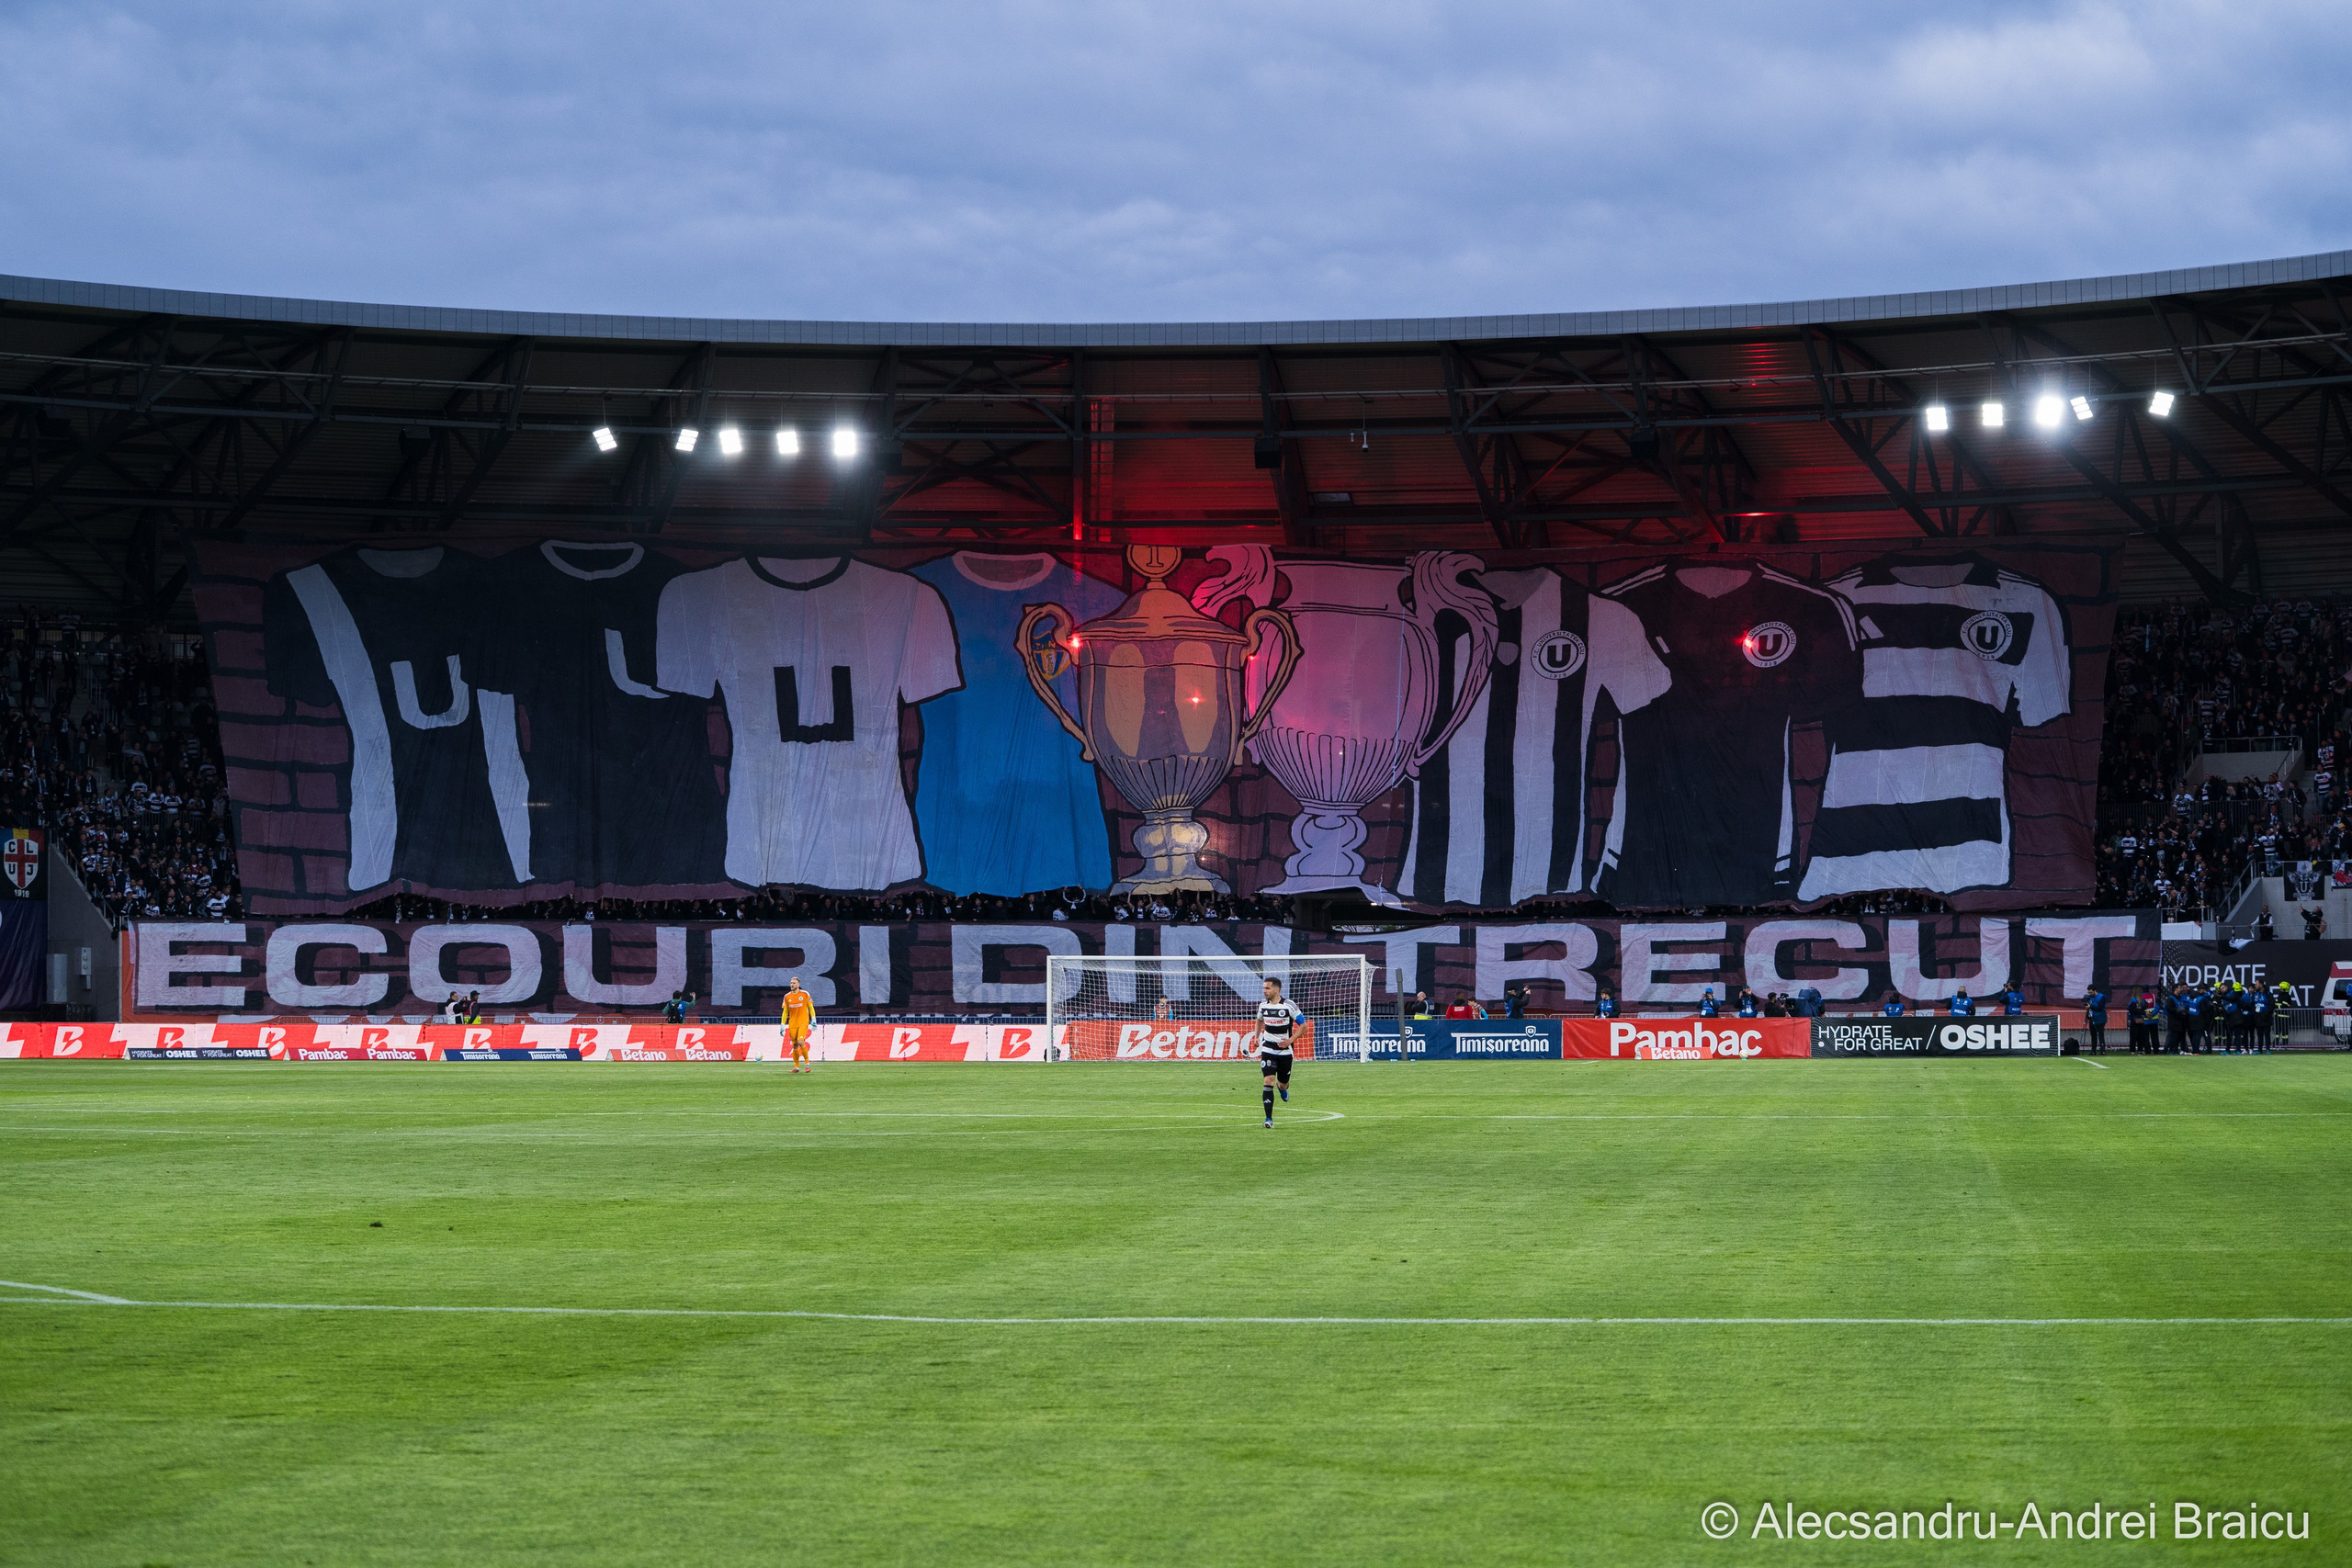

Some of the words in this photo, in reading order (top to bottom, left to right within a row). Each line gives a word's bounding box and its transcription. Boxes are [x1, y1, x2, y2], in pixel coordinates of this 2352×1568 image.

[1758, 633, 1783, 657] U
[1975, 626, 1999, 650] U
[1547, 643, 1571, 669] U
[390, 653, 469, 730] U
[772, 663, 854, 743] U
[14, 889, 29, 897] 1919
[137, 921, 891, 1008] ECOURI
[951, 921, 1292, 1005] DIN
[1342, 915, 2137, 1005] TRECUT
[1610, 1021, 1763, 1056] Pambac
[1818, 1025, 1892, 1038] HYDRATE
[1939, 1024, 2051, 1050] OSHEE
[1116, 1024, 1264, 1058] Betano
[1328, 1033, 1426, 1055] Timșorena
[1834, 1038, 1869, 1051] FOR
[1870, 1038, 1923, 1051] GREAT
[165, 1050, 198, 1058] OSHEE
[235, 1049, 267, 1057] OSHEE
[298, 1048, 348, 1060] Pambac
[367, 1048, 417, 1060] Pambac
[620, 1049, 667, 1061] Betano
[684, 1049, 732, 1061] Betano
[1651, 1048, 1701, 1060] Betano
